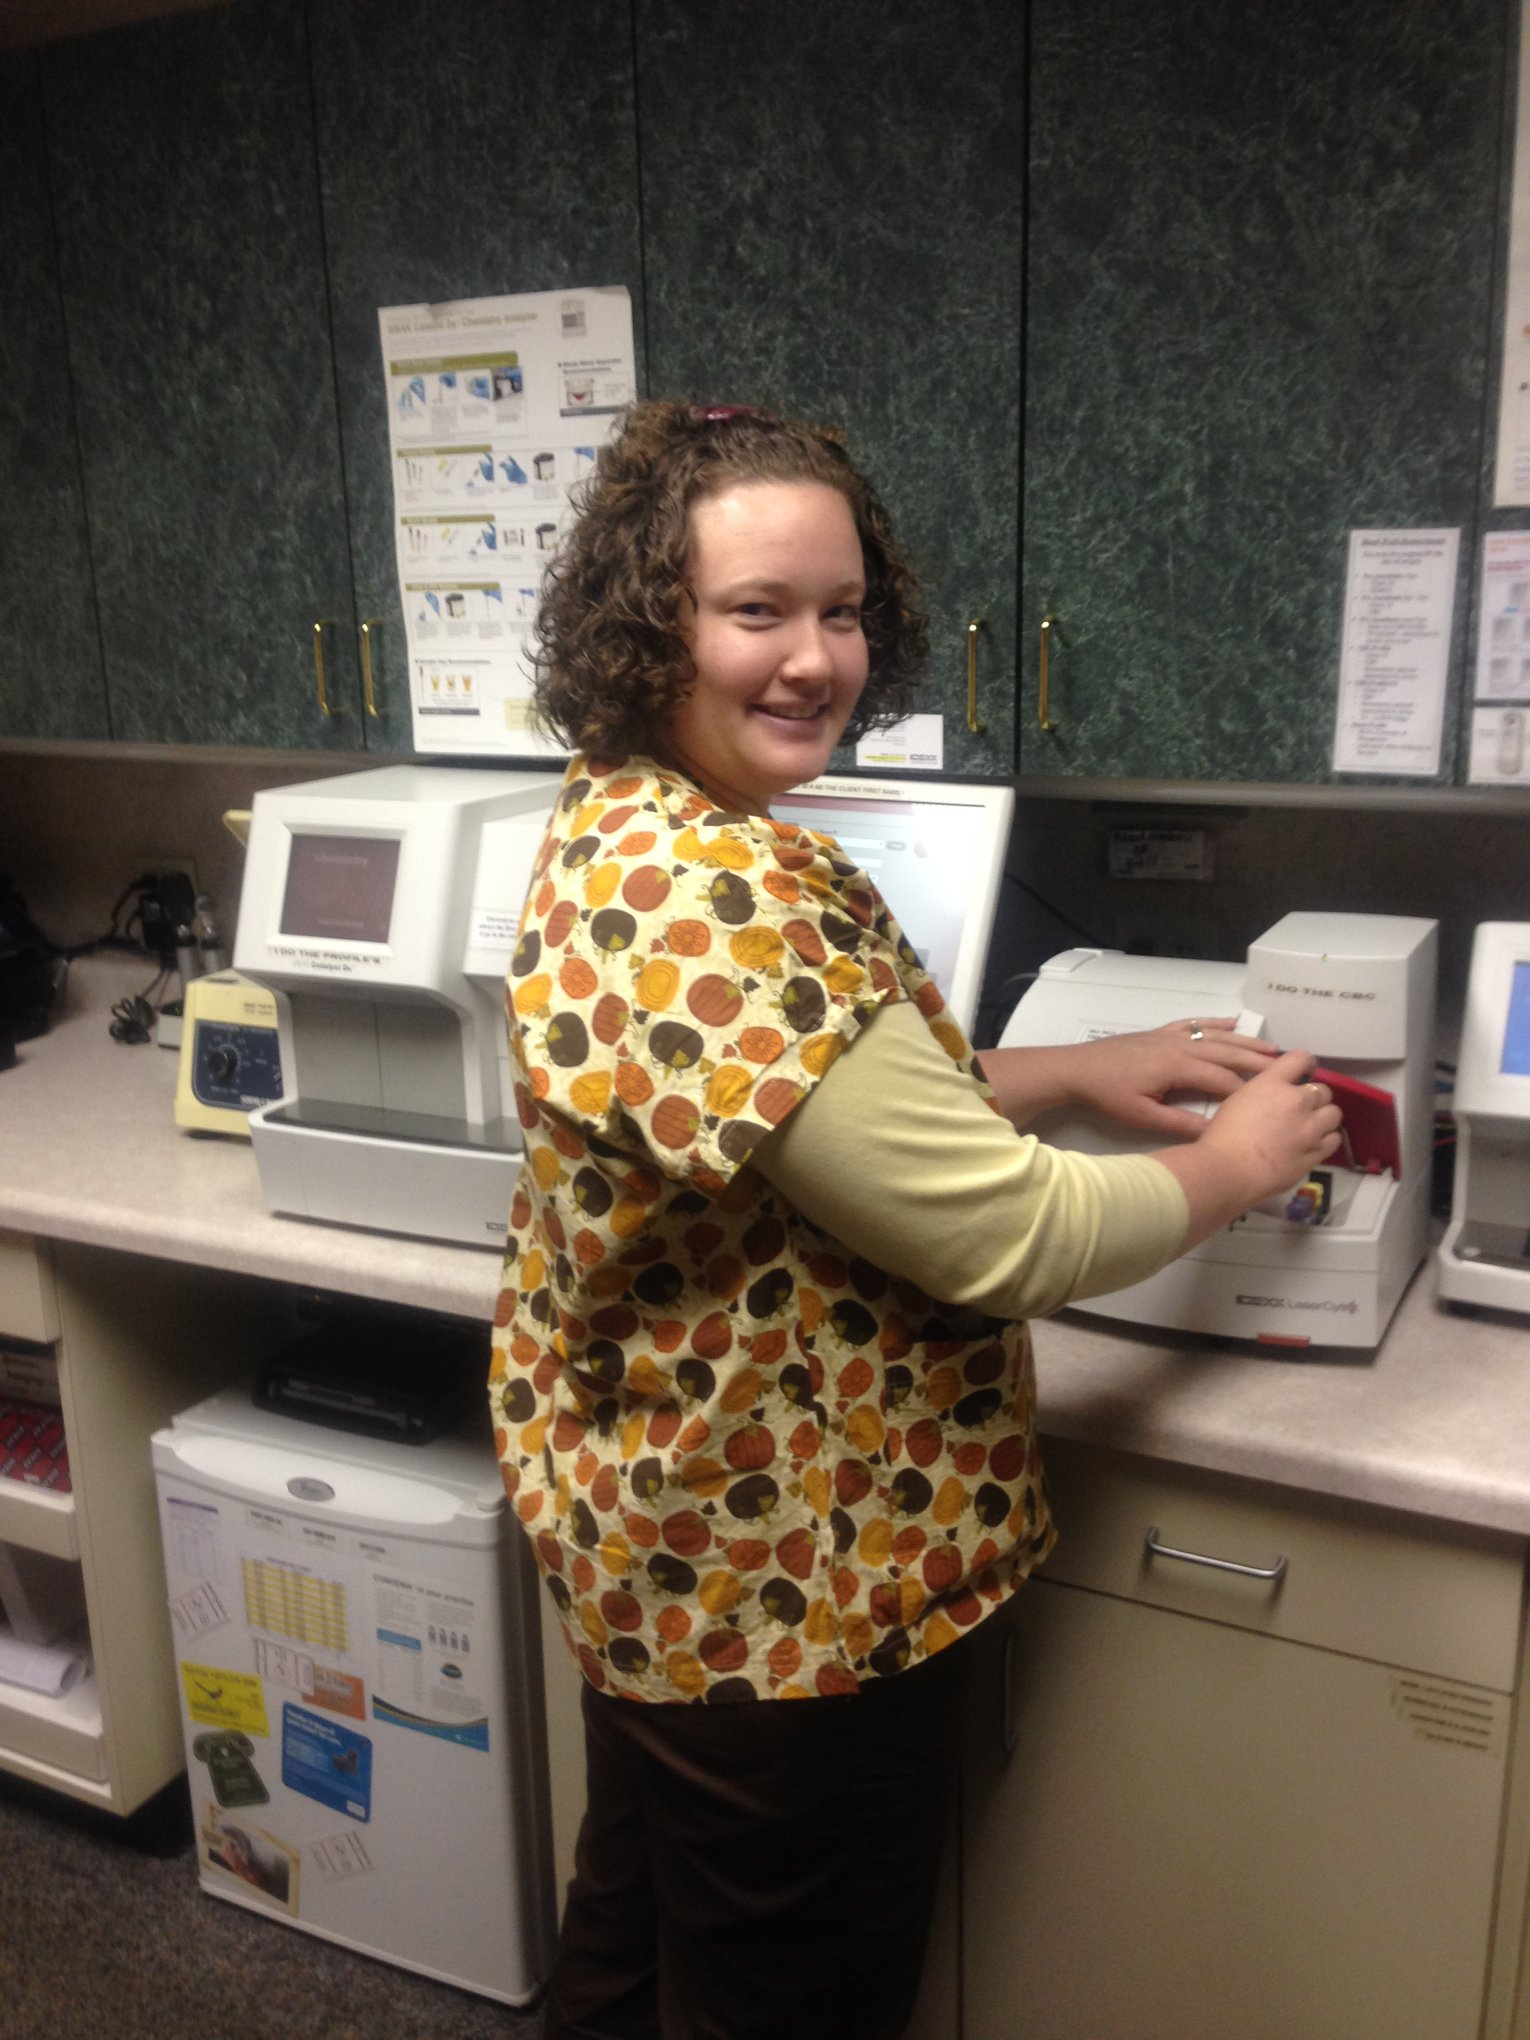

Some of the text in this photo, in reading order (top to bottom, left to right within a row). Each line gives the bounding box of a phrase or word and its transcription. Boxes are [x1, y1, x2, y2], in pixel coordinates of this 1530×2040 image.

[299, 950, 320, 958] THE
[1275, 984, 1298, 993] DO
[1302, 987, 1334, 998] THE
[1339, 991, 1376, 1001] CBC
